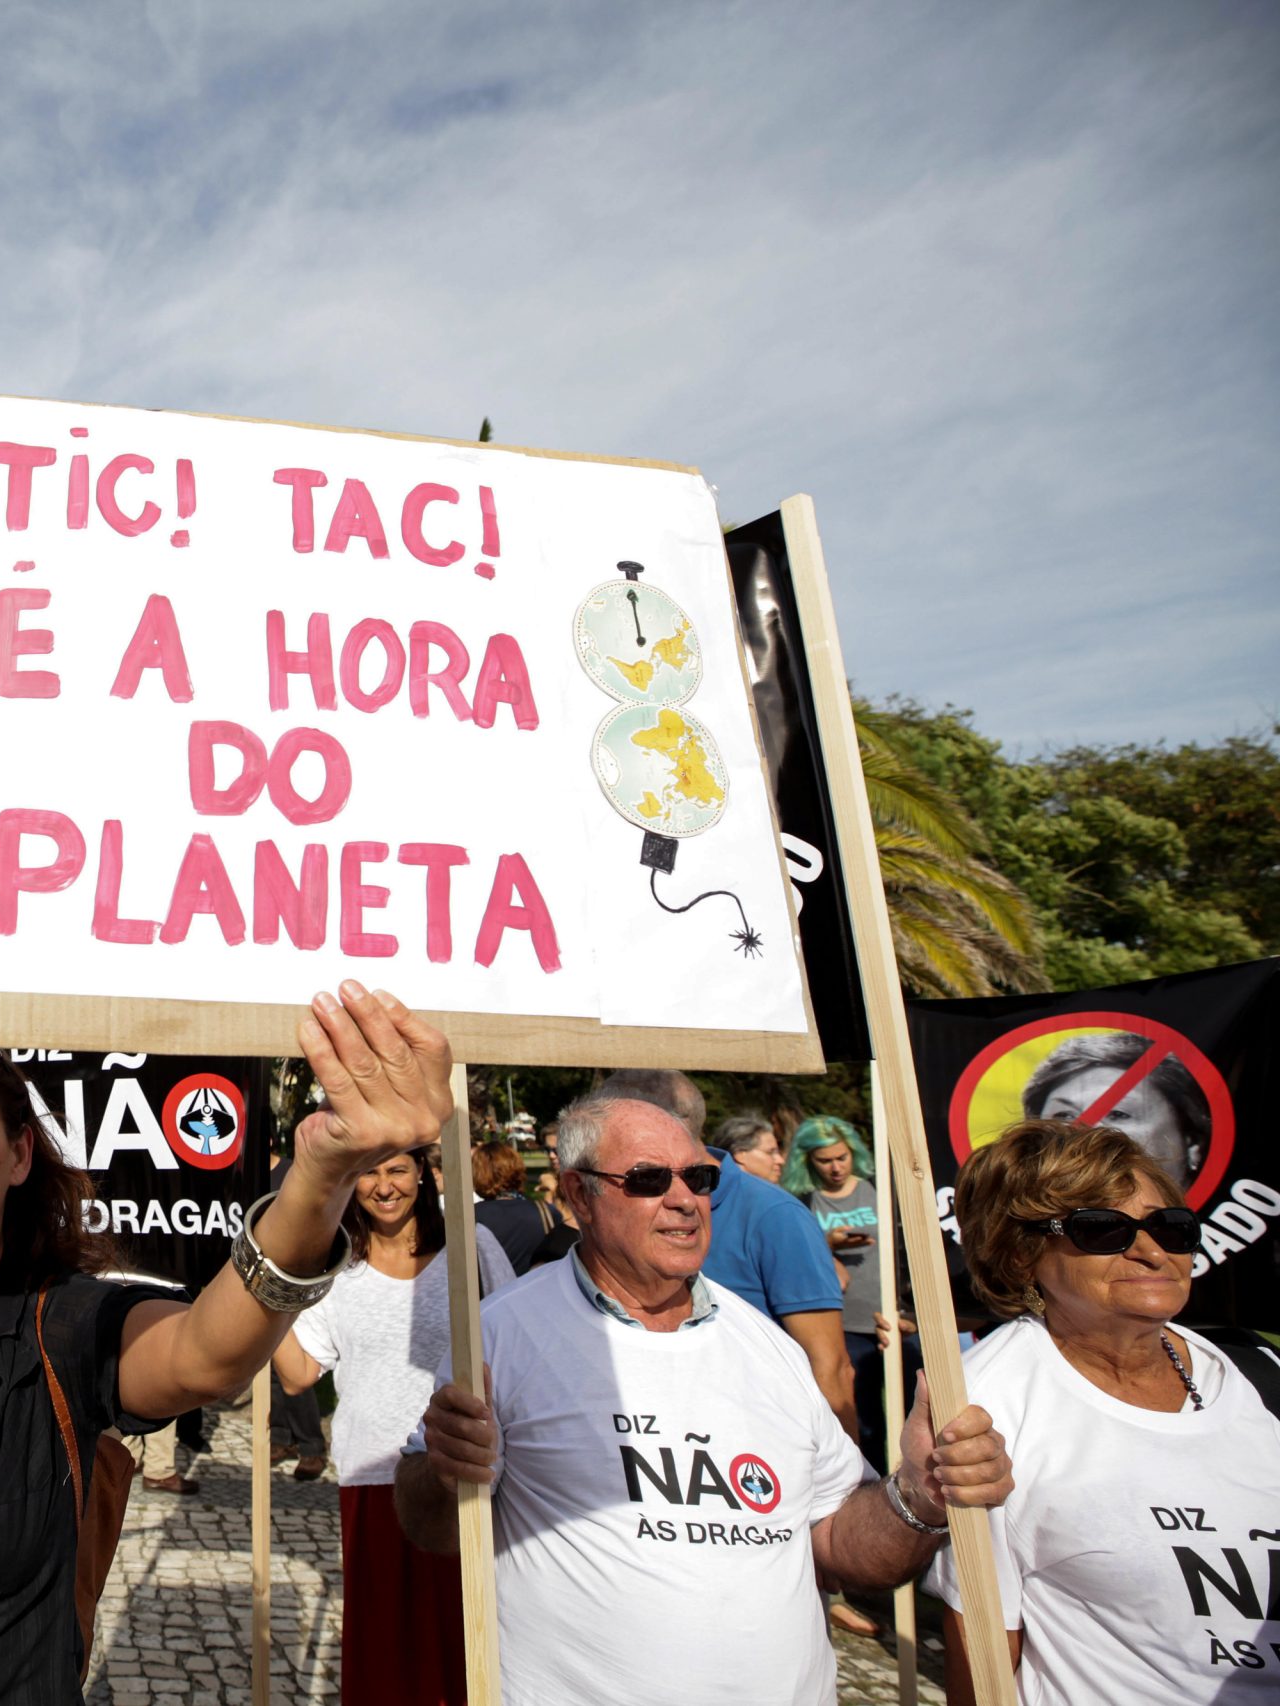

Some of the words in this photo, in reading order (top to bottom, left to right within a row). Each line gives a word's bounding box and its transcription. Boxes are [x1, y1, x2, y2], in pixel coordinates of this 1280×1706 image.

[272, 467, 501, 580] TAC!
[110, 593, 194, 704] A
[266, 608, 540, 732] HORA
[188, 720, 352, 826] DO
[81, 1199, 245, 1239] DRAGAS
[816, 1206, 877, 1231] VANS
[612, 1413, 661, 1435] DIZ
[636, 1512, 677, 1542] ÀS
[1149, 1506, 1218, 1532] DIZ
[1205, 1628, 1266, 1669] ÀS
